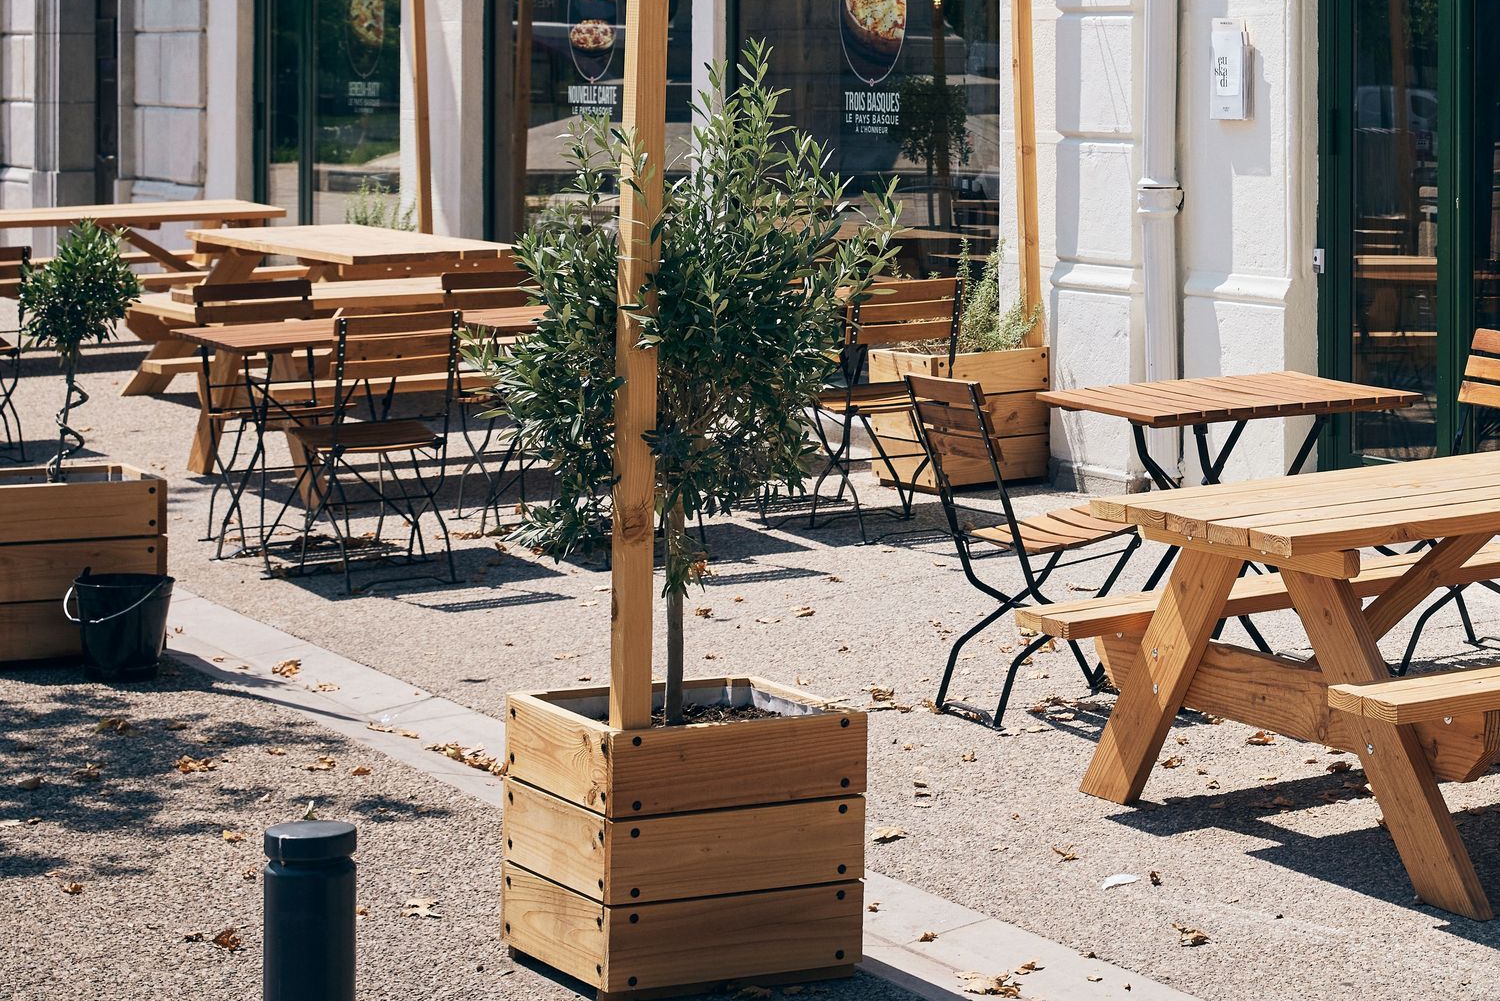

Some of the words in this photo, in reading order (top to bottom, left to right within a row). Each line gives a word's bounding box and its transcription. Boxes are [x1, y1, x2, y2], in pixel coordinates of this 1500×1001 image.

[568, 86, 597, 104] NOUVELLE
[598, 86, 617, 104] CARTE
[844, 91, 866, 111] TROIS
[866, 91, 900, 113] BASQUES
[572, 106, 578, 114] LE
[845, 113, 853, 123] LE
[854, 114, 871, 124] PAYS
[872, 114, 900, 125] BASQUE
[860, 125, 889, 134] L'HONNEUR
